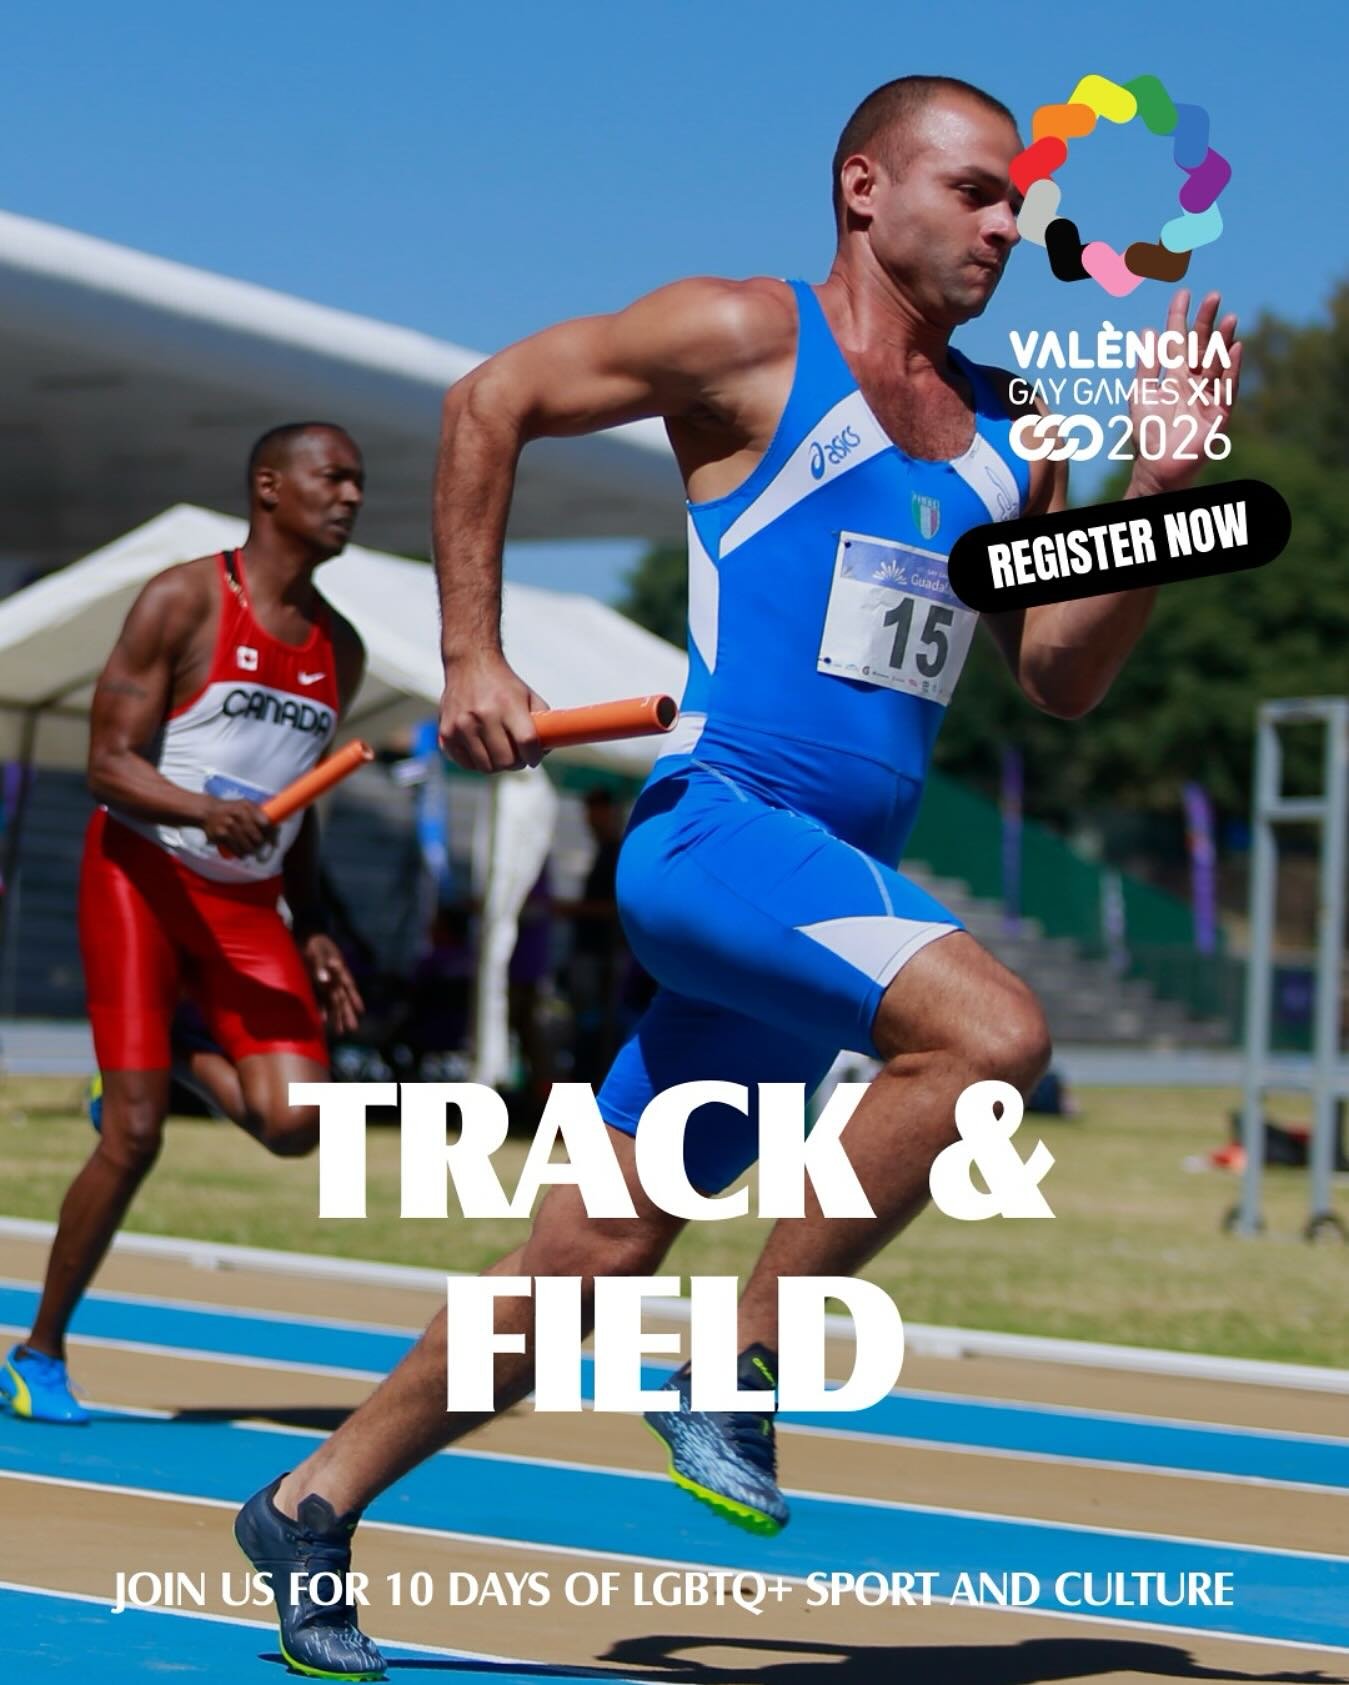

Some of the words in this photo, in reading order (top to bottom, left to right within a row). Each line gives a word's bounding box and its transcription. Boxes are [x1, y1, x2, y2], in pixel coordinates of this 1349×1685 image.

[911, 574, 951, 594] Guada
[882, 597, 954, 678] 15
[222, 689, 332, 737] CANADA
